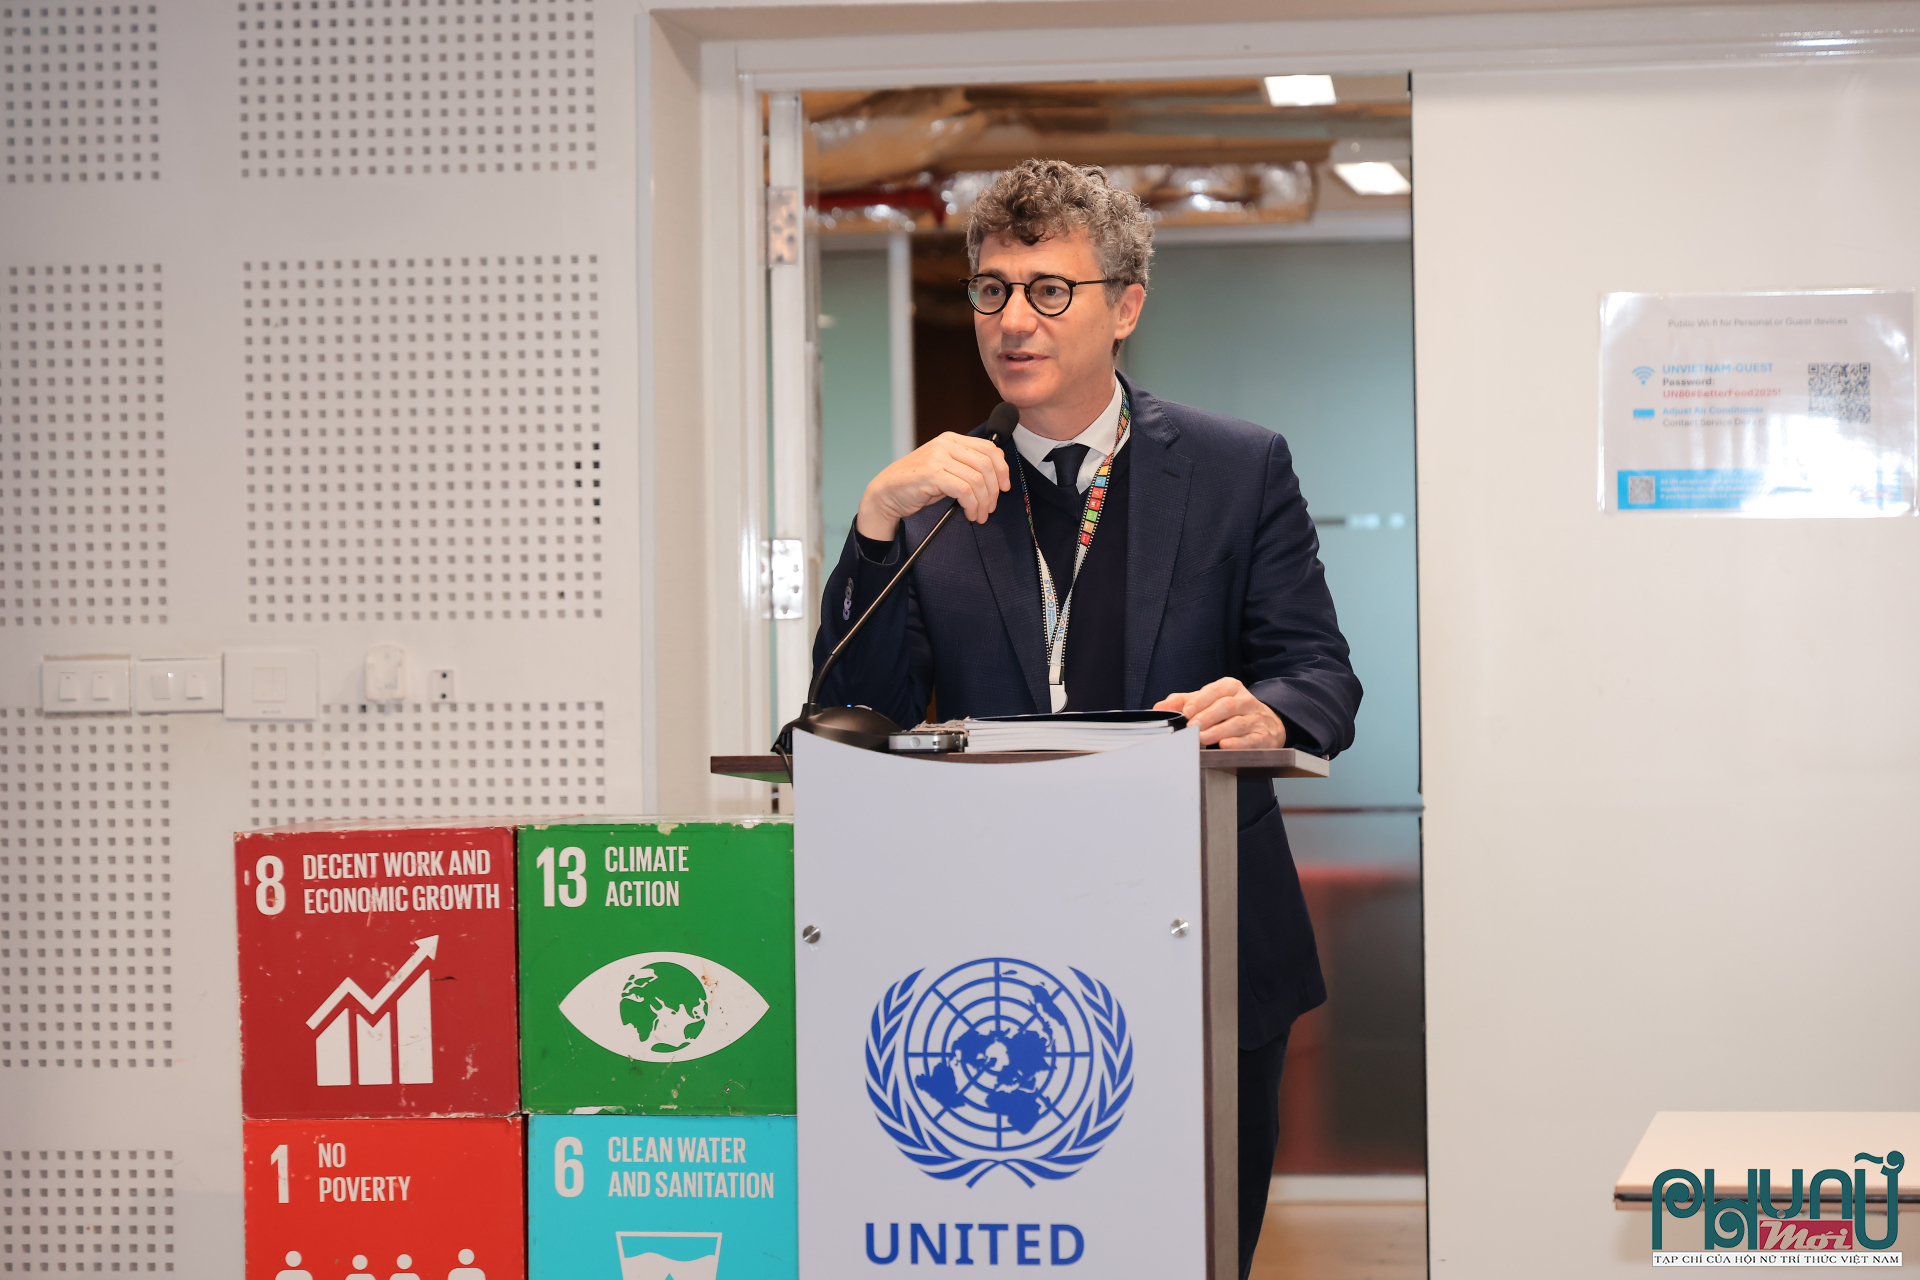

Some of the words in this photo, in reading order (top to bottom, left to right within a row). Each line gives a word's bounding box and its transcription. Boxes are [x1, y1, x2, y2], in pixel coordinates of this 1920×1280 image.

[1667, 318, 1696, 328] Public
[1720, 318, 1732, 327] for
[1734, 317, 1773, 327] Personal
[1785, 316, 1812, 326] Guest
[1814, 316, 1849, 326] devices
[1662, 362, 1774, 374] UNVIETNAM-GUEST
[1662, 377, 1716, 386] Password:
[1662, 407, 1692, 416] Adjust
[1044, 579, 1055, 609] GOALS
[302, 852, 380, 880] DECENT
[382, 850, 445, 878] WORK
[448, 849, 491, 876] AND
[604, 845, 690, 873] CLIMATE
[255, 855, 286, 916] 8
[536, 846, 588, 908] 13
[303, 885, 409, 914] ECONOMIC
[412, 883, 500, 912] GROWTH
[604, 880, 680, 907] ACTION
[318, 1142, 347, 1168] NO
[607, 1136, 672, 1163] CLEAN
[676, 1136, 747, 1164] WATER
[270, 1144, 290, 1204] 1
[554, 1136, 585, 1198] 6
[318, 1175, 411, 1203] POVERTY
[607, 1170, 651, 1198] AND
[655, 1171, 775, 1199] SANITATION
[865, 1222, 1085, 1266] UNITED
